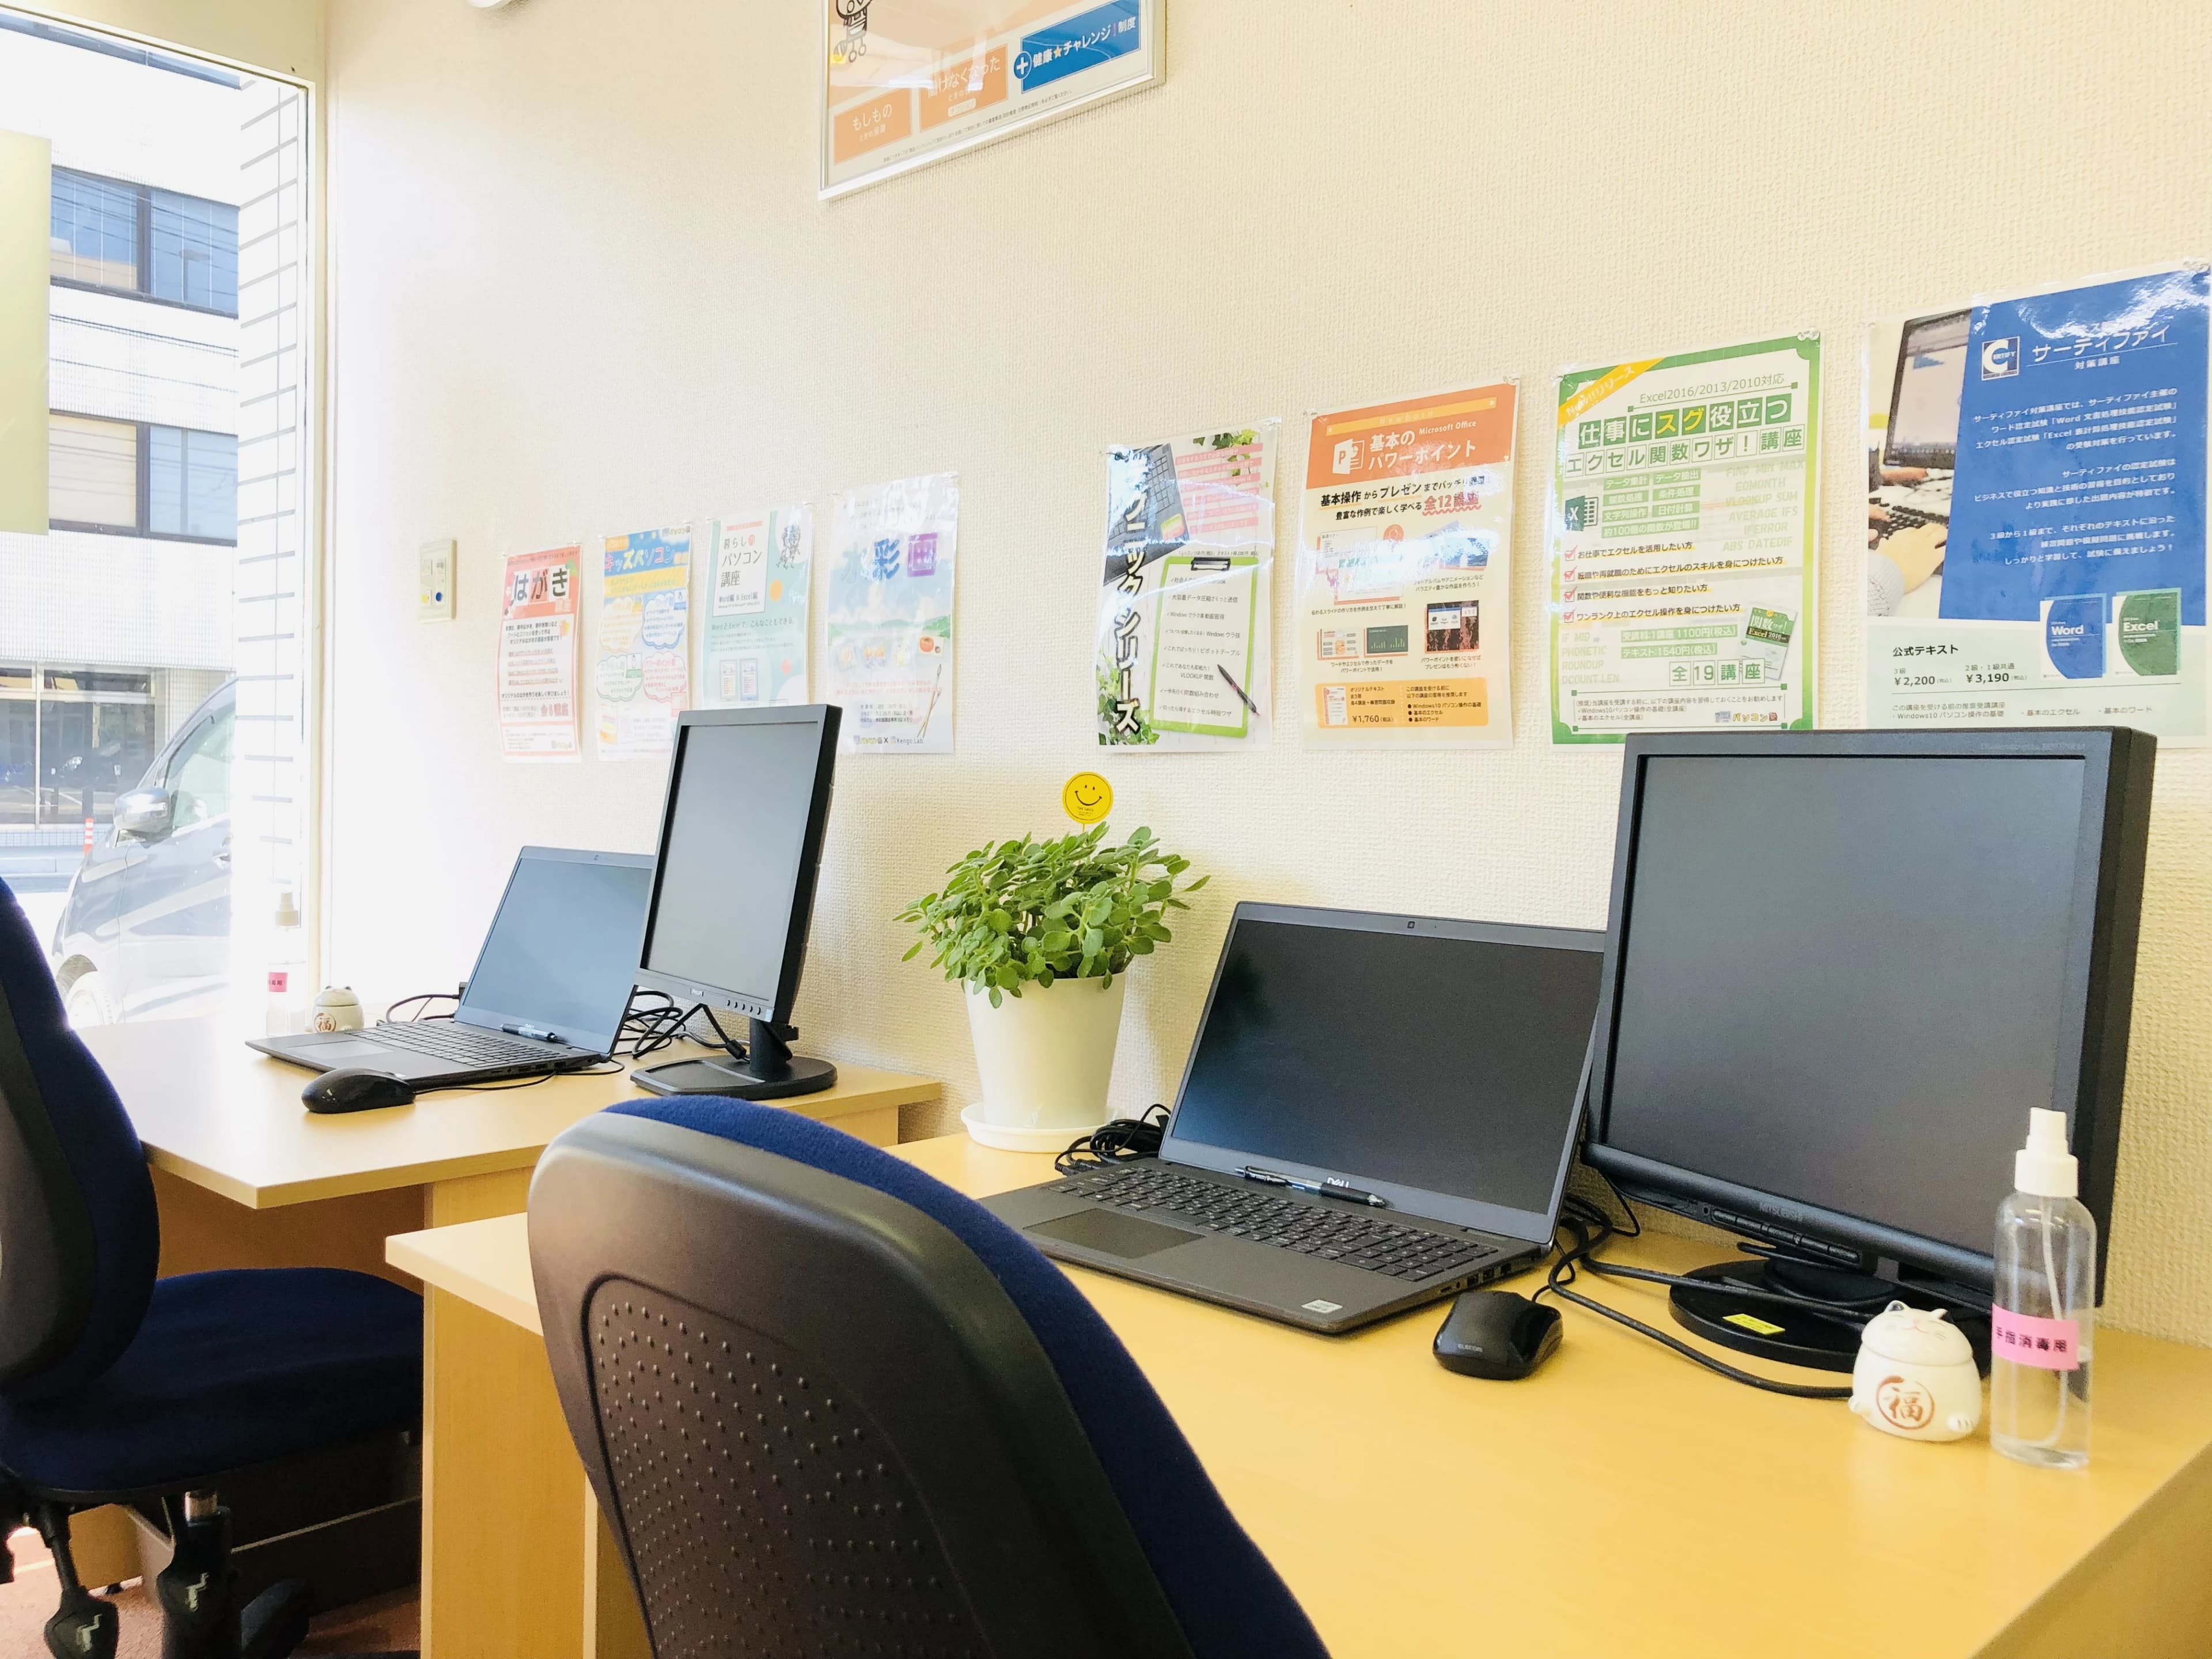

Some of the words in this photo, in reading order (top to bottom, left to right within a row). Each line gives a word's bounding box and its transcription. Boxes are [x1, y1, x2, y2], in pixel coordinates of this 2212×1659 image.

[853, 104, 892, 131] もしもの
[2033, 325, 2171, 362] サーティファイ
[1640, 373, 1785, 403] Excel2016/2013/2010対応
[1419, 424, 1455, 435] Microsoft
[1456, 420, 1477, 431] Office
[1580, 399, 1789, 446] 仕事にスグ役立つ
[1369, 430, 1415, 452] 基本の
[1368, 440, 1477, 471] パワーポイント
[1776, 491, 1798, 502] SUM
[1577, 542, 1692, 559] お仕事でエクセルを活用したい方
[1722, 540, 1744, 552] ABS
[1748, 536, 1793, 550] DATEDIF
[722, 550, 762, 567] パソコン
[514, 567, 569, 601] はがき
[720, 570, 741, 588] 講座
[1576, 603, 1741, 622] ワンランク上のエクセル操作を身につけたい方
[2051, 624, 2084, 636] Word
[2123, 620, 2158, 632] Excel
[1892, 644, 1959, 657] 公式テキスト
[1883, 1386, 1925, 1421] 福
